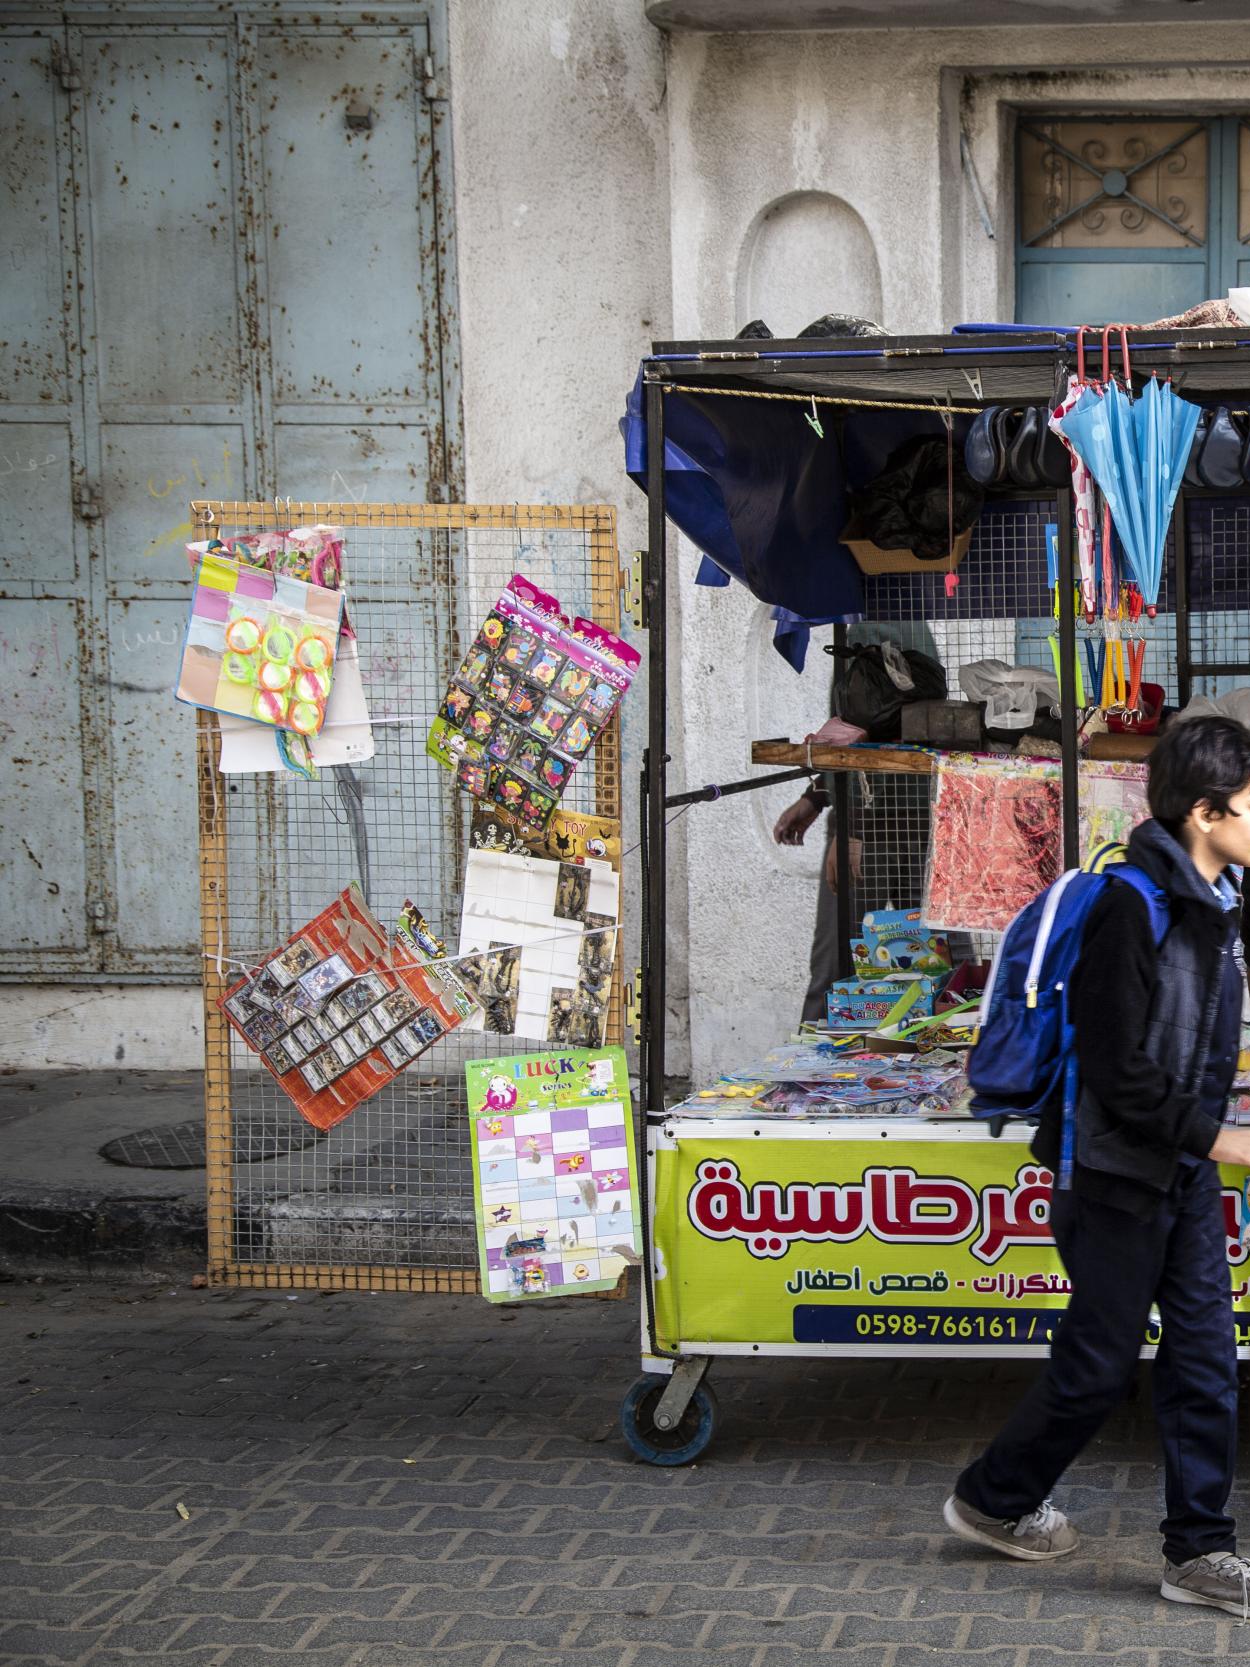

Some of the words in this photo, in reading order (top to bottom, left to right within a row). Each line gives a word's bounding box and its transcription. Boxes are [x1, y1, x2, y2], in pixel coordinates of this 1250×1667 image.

[563, 821, 588, 836] TOY
[869, 1271, 949, 1295] قصص
[856, 1314, 1016, 1337] 0598-766161
